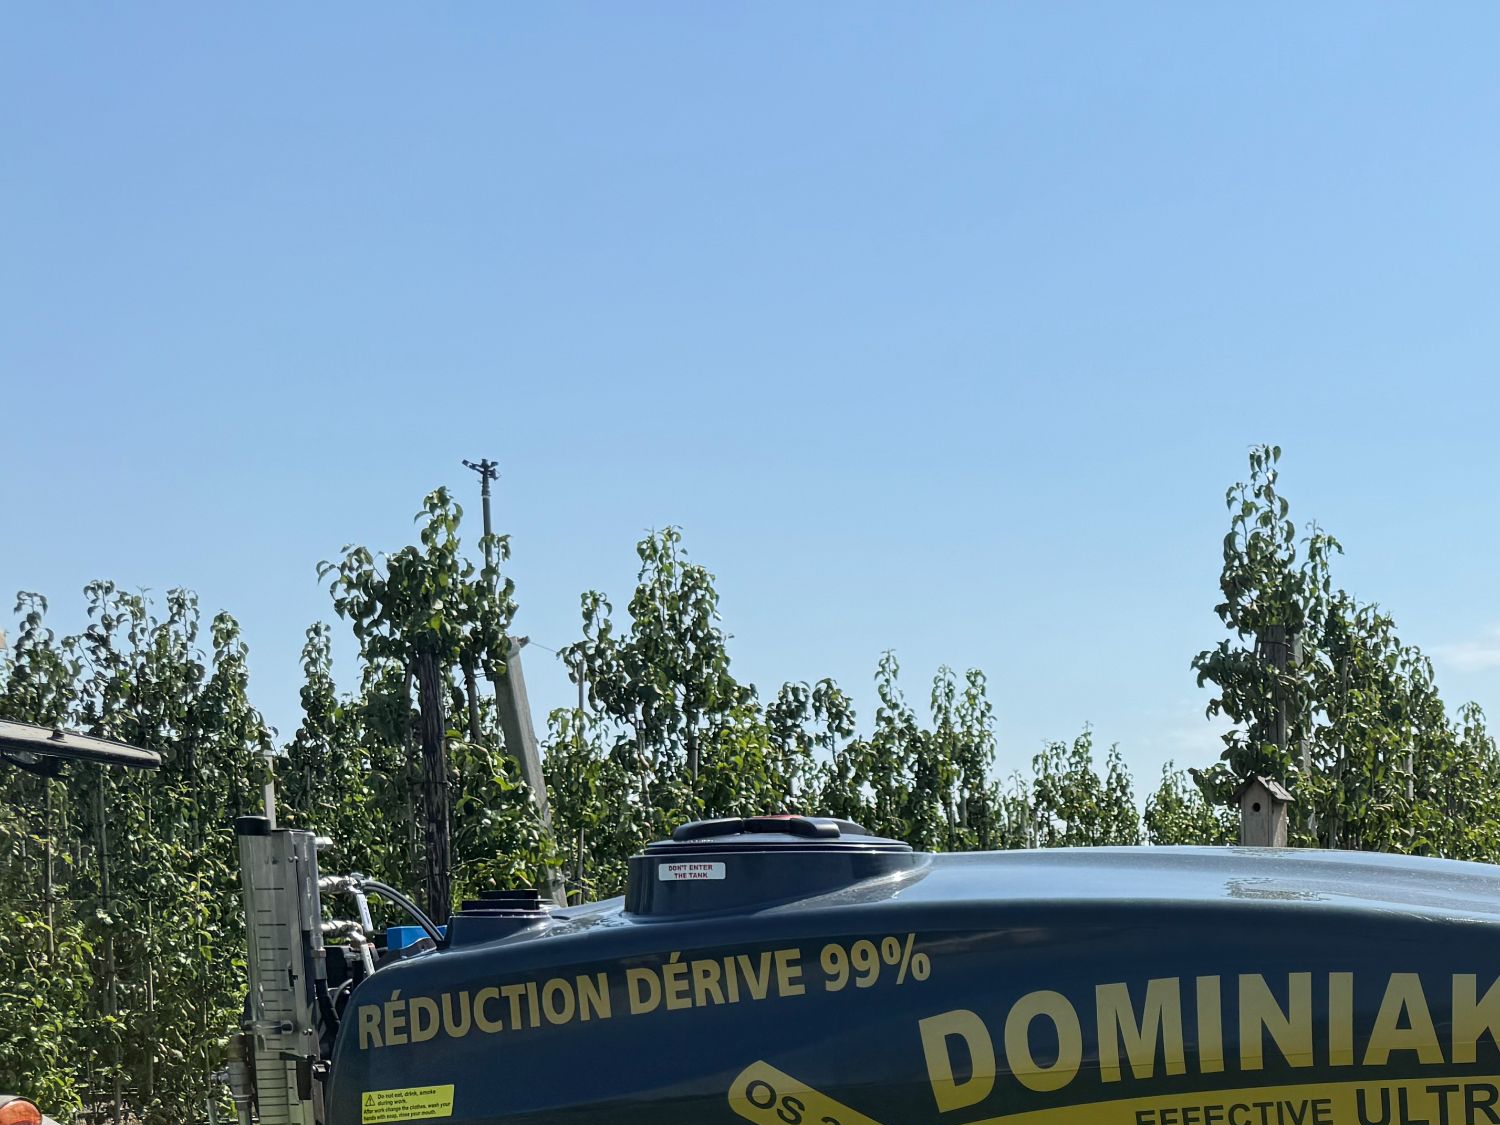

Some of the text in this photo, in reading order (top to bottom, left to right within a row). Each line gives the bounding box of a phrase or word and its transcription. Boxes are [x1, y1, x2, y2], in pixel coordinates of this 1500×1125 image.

[668, 864, 687, 872] DON'T
[358, 933, 931, 1050] RÉDUCTION DÉRIVE 99%
[410, 1110, 421, 1118] your
[745, 1079, 806, 1125] OS
